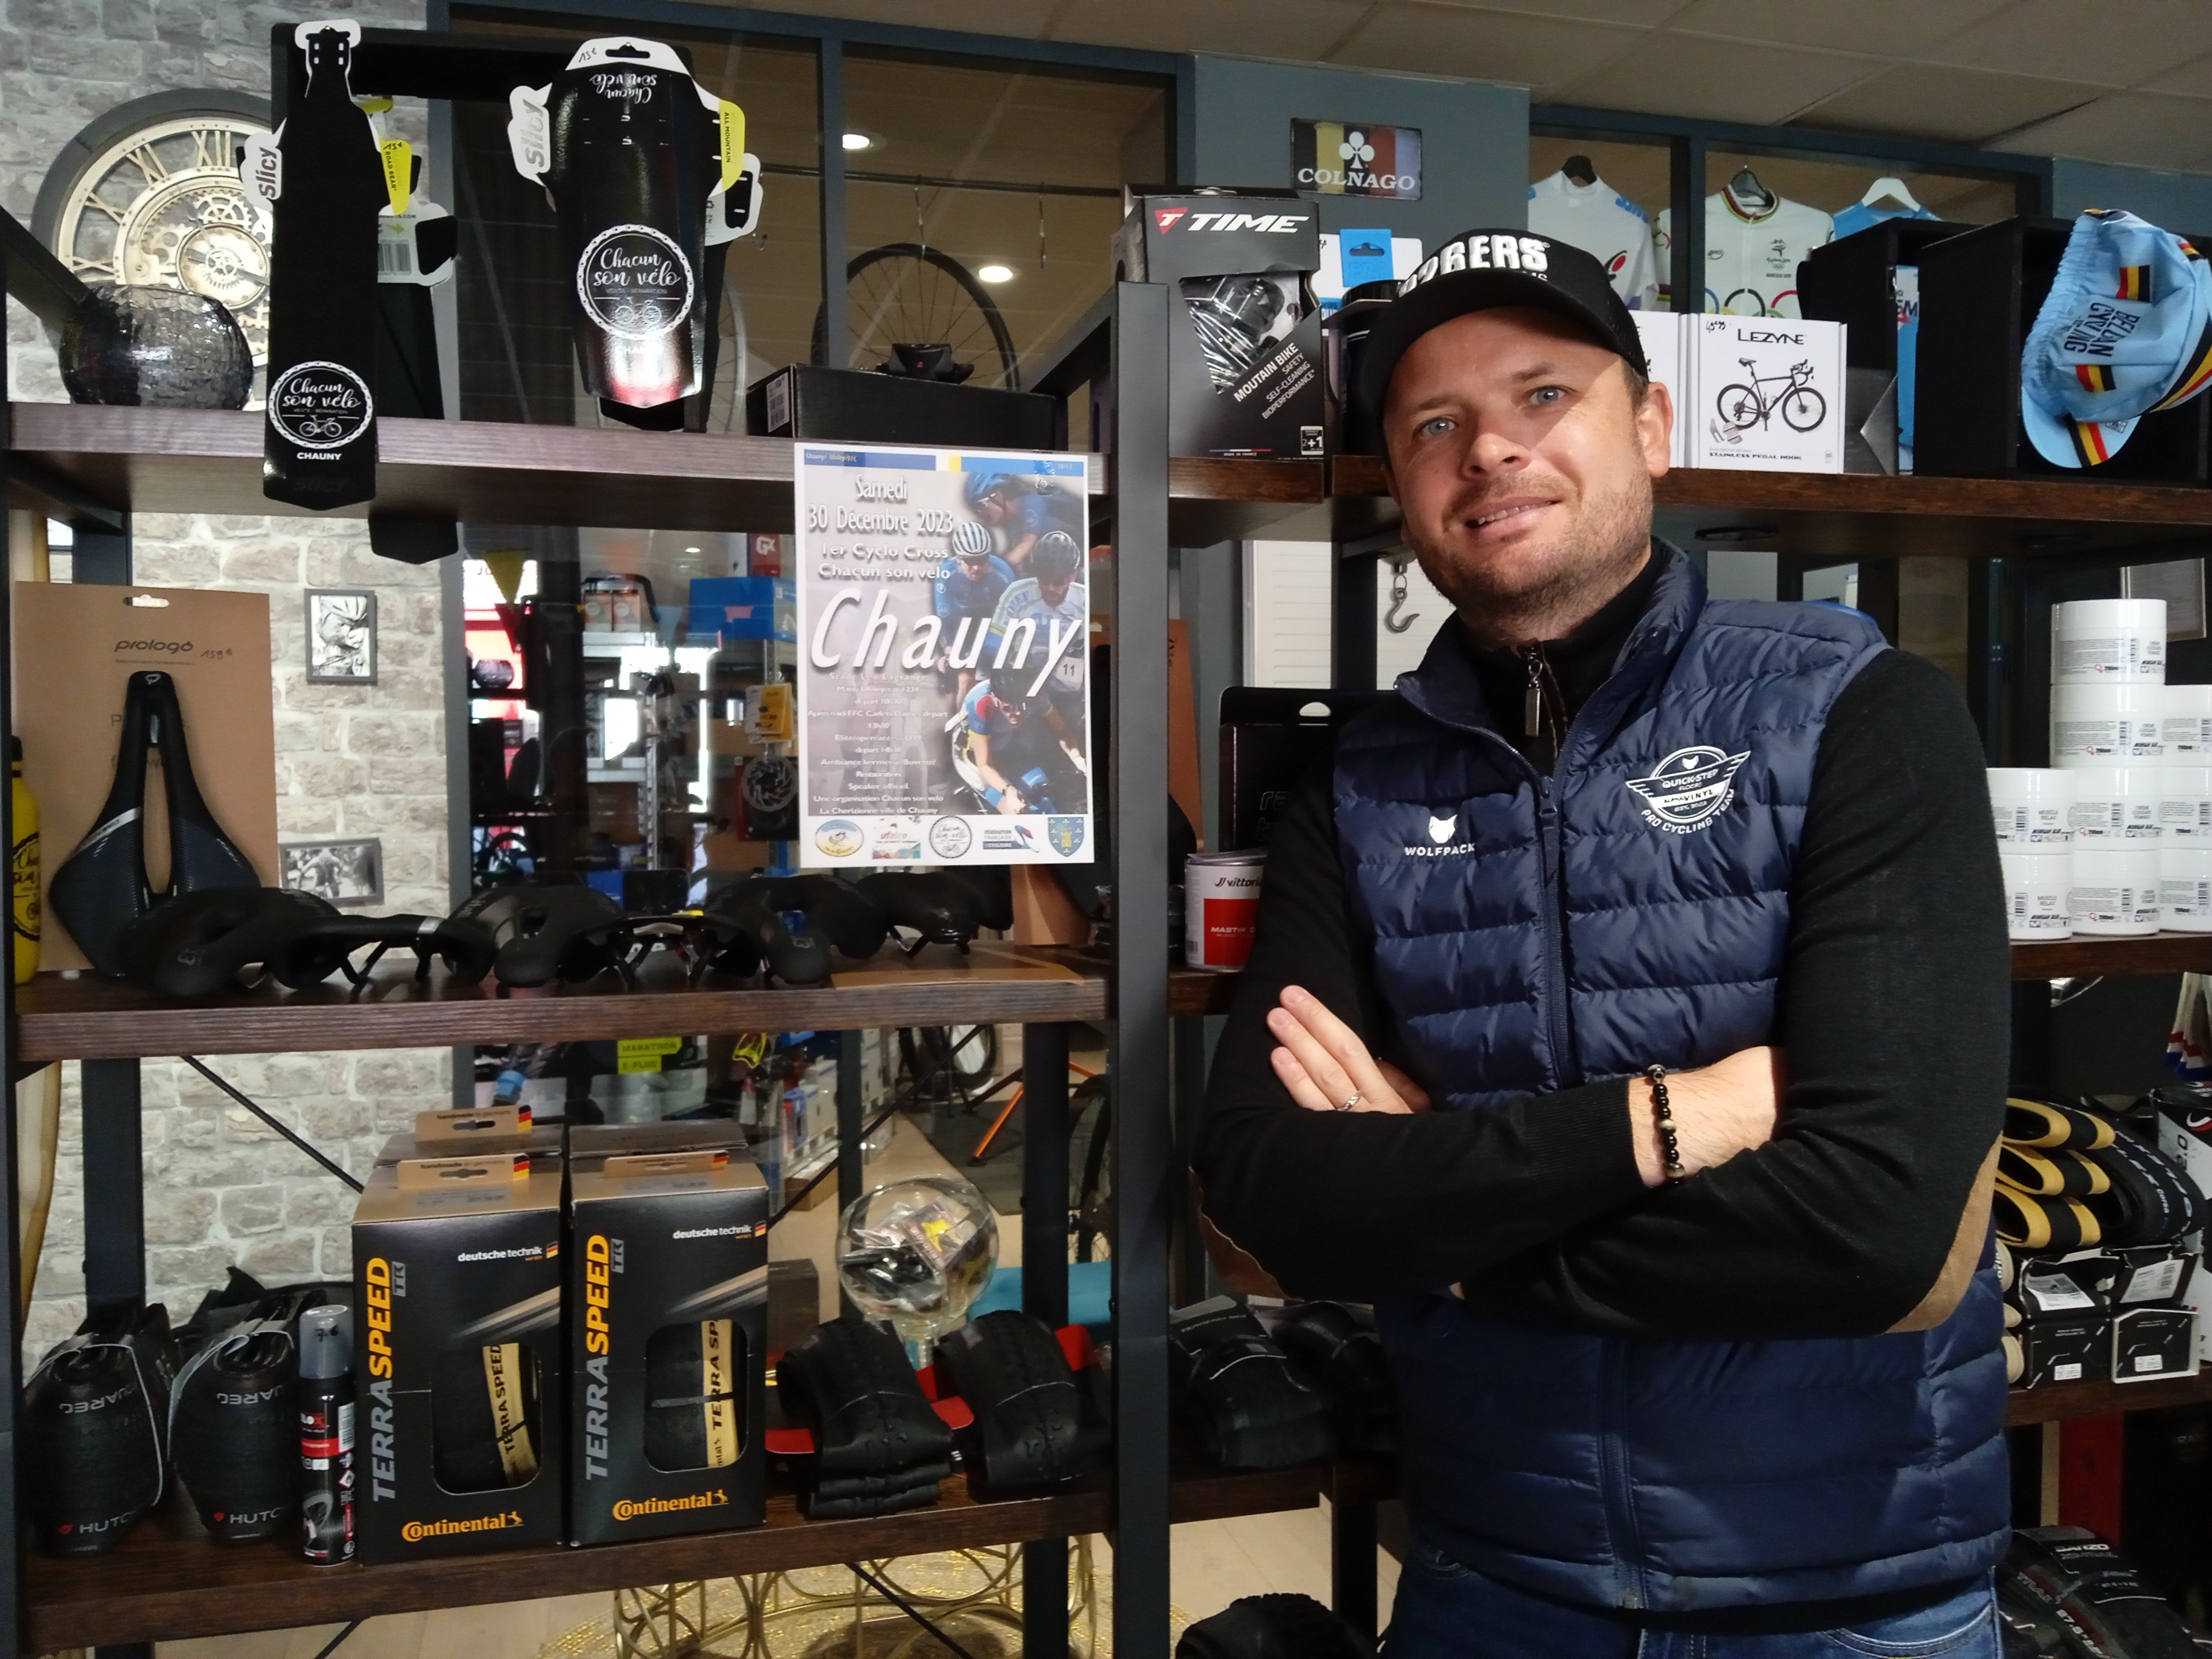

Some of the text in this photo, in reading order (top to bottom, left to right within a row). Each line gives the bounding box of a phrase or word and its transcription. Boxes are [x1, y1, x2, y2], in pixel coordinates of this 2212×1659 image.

[385, 151, 393, 170] ROAD
[1297, 167, 1417, 191] COLNAGO
[1187, 213, 1310, 233] TIME
[600, 247, 662, 270] Chacun
[593, 260, 681, 287] son vélo
[1737, 328, 1804, 346] LEZYNE
[1233, 342, 1299, 403] MOUTAIN BIKE
[1281, 352, 1304, 375] SAFETY
[290, 377, 345, 395] Chacun
[1266, 361, 1311, 403] SELF-CLEANING
[282, 389, 362, 408] son vélo
[296, 452, 342, 460] CHAUNY
[856, 474, 908, 500] Samedi
[808, 504, 954, 533] 30 Décembre 2023
[822, 542, 949, 564] 1er Cyclo Cross
[818, 563, 951, 581] Chacun son velo
[113, 639, 194, 655] prologo
[810, 588, 1083, 698] Chauny
[829, 672, 858, 681] Stade
[882, 673, 927, 683] Lagrange
[848, 783, 881, 791] Speaker
[1662, 768, 1719, 790] QUICK-STEP
[1640, 788, 1736, 835] PRO CYCLING TEAM
[1403, 842, 1476, 857] WOLFPACK
[622, 1042, 677, 1052] MARATHON
[672, 1224, 752, 1239] deutsche technik
[457, 1246, 542, 1262] deutsche technik
[489, 1344, 516, 1455] TERRA SPEED
[710, 1354, 723, 1430] TERRA
[612, 1491, 713, 1522] Continental
[401, 1514, 508, 1543] Continental
